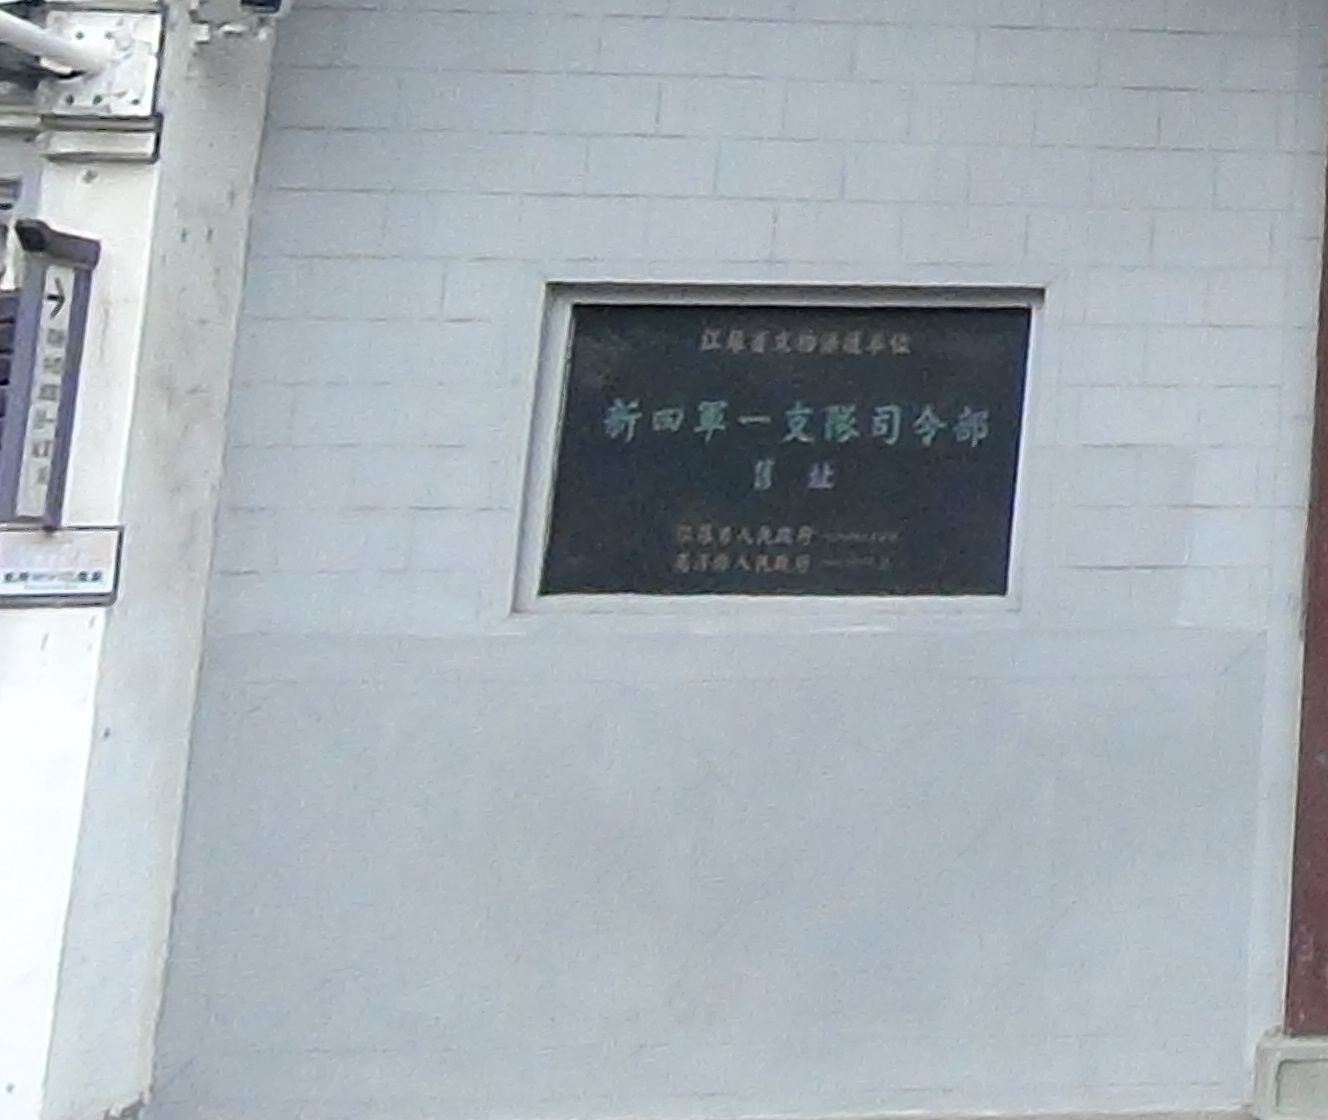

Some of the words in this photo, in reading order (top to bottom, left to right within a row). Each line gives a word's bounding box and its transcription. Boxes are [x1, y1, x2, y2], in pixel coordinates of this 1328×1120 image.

[603, 397, 991, 448] 新四軍一支隊司令部
